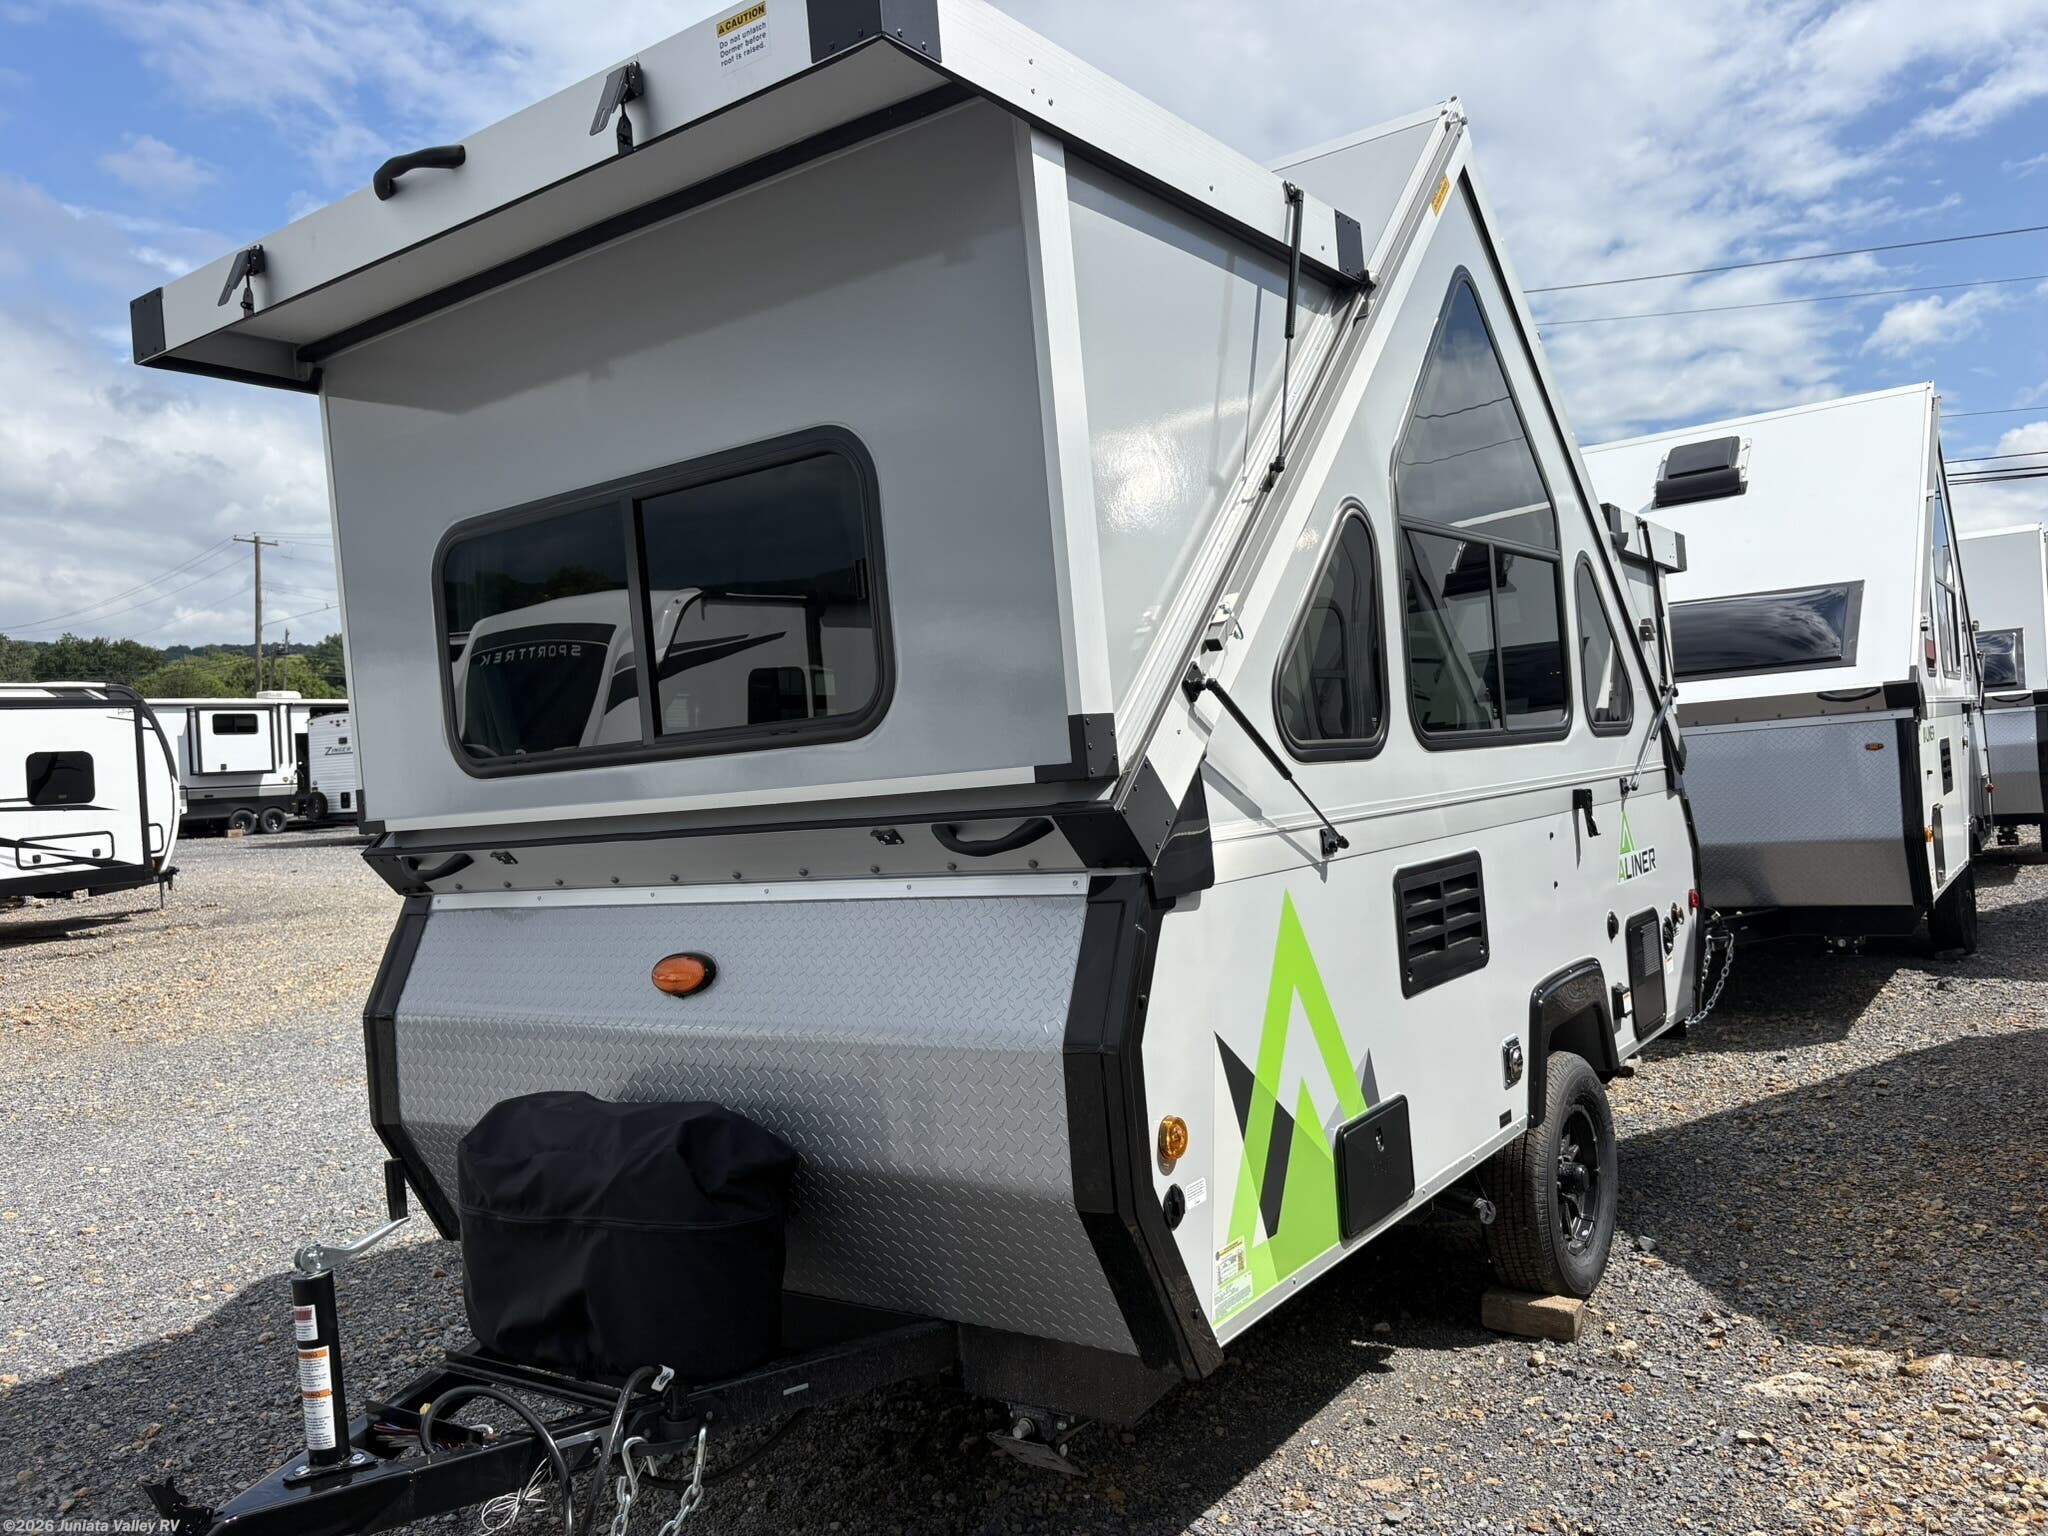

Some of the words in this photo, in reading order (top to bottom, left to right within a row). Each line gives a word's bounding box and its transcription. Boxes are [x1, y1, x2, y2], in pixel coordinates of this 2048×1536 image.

[725, 5, 765, 30] CAUTION
[719, 41, 728, 50] Do
[729, 34, 741, 44] not
[742, 22, 767, 38] unlatch
[720, 42, 743, 58] Dormer
[745, 31, 767, 46] before
[720, 55, 735, 67] roof
[736, 52, 742, 60] is
[743, 42, 767, 57] raised.
[1618, 847, 1657, 883] ALINER
